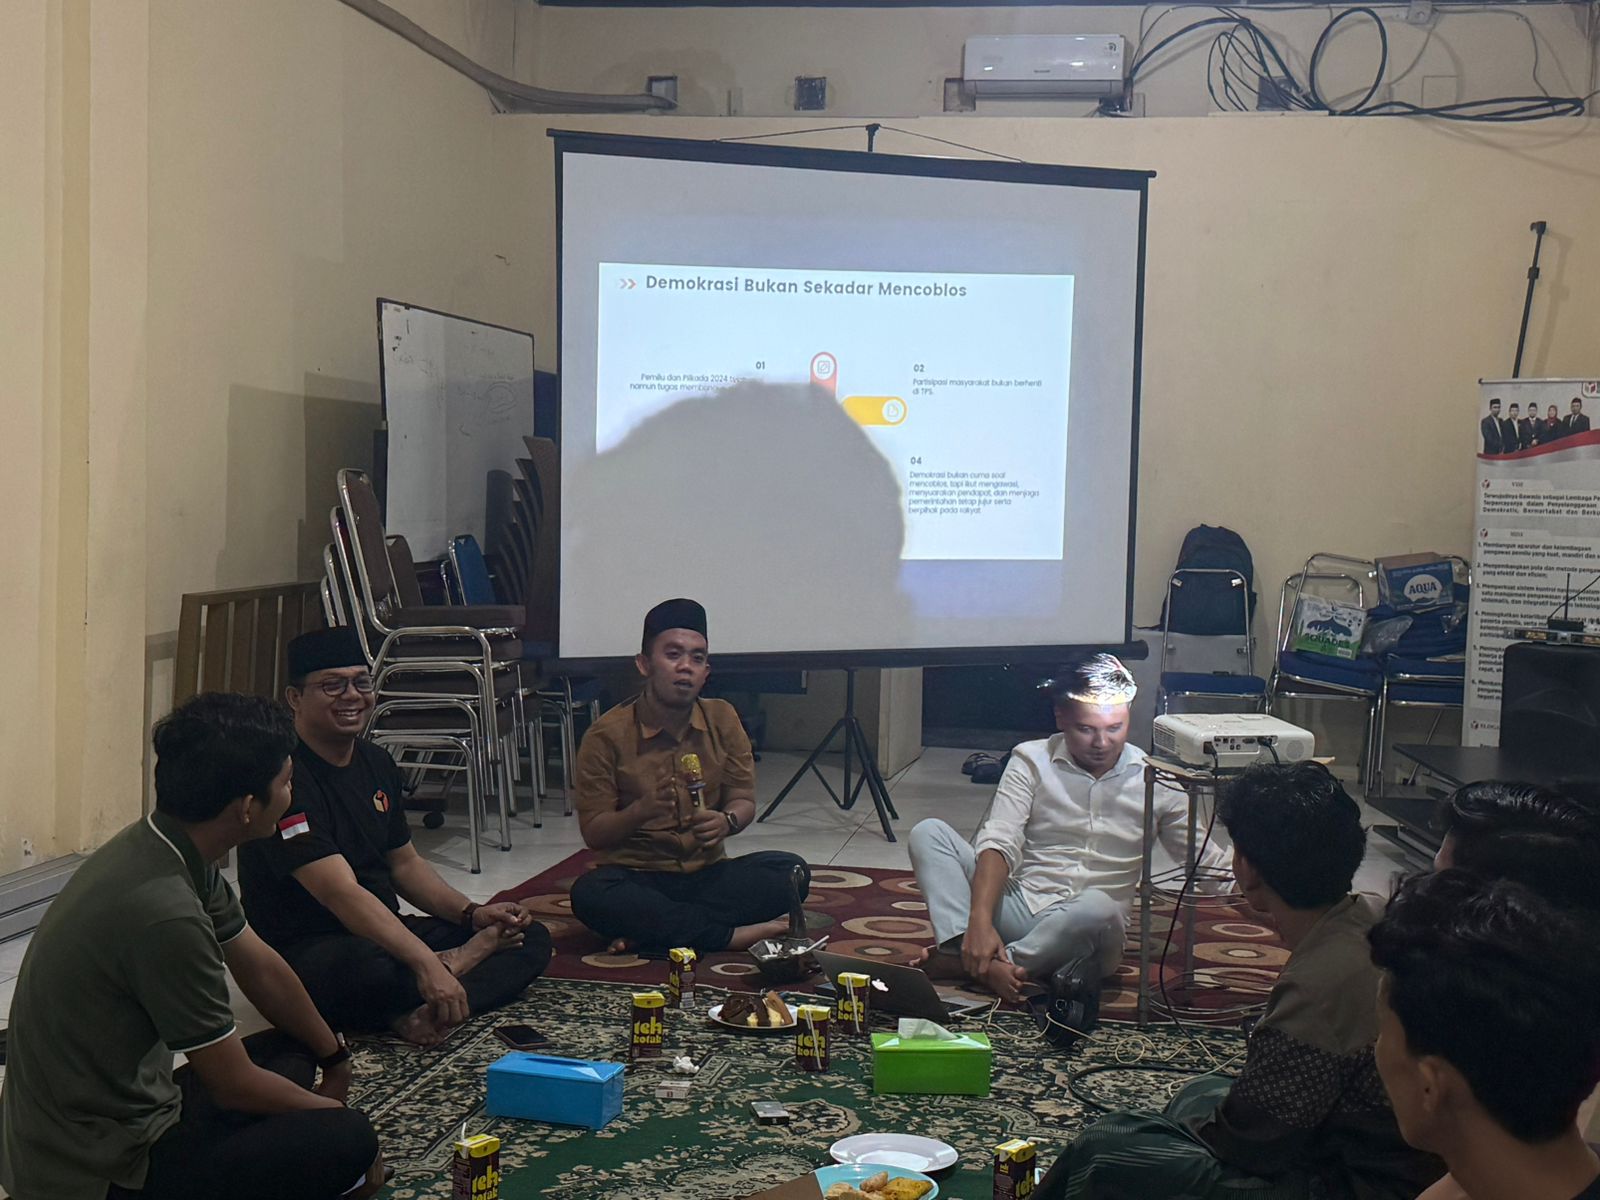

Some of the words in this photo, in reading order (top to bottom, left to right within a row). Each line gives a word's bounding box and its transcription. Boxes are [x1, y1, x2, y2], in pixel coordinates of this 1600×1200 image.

[646, 275, 738, 292] Demokrasi
[744, 278, 798, 294] Bukan
[804, 280, 873, 295] Sekadar
[878, 282, 966, 298] Mencoblos
[756, 361, 766, 370] 01
[914, 364, 924, 372] 02
[641, 373, 666, 381] Pemilu
[667, 373, 682, 382] dan
[683, 374, 708, 382] Pilkada
[710, 374, 728, 382] 2024
[912, 378, 948, 387] Partisipasi
[950, 380, 990, 388] masyarakat
[992, 379, 1012, 387] bukan
[658, 384, 678, 392] tugas
[910, 456, 922, 464] 04
[910, 471, 946, 479] Demokrasi
[947, 471, 968, 479] bukan
[950, 480, 964, 489] tapi
[909, 489, 956, 498] menyuarakan
[1008, 490, 1040, 498] menjaga
[908, 498, 957, 506] pemerintahan
[958, 498, 976, 507] tetap
[978, 498, 992, 507] jujur
[908, 506, 938, 515] berpihak
[940, 507, 958, 516] pada
[1409, 582, 1437, 594] AQUA
[838, 995, 864, 1013] teh
[634, 1016, 662, 1035] teh
[633, 1034, 662, 1044] kotak
[798, 1029, 826, 1048] teh
[472, 1165, 498, 1194] teh
